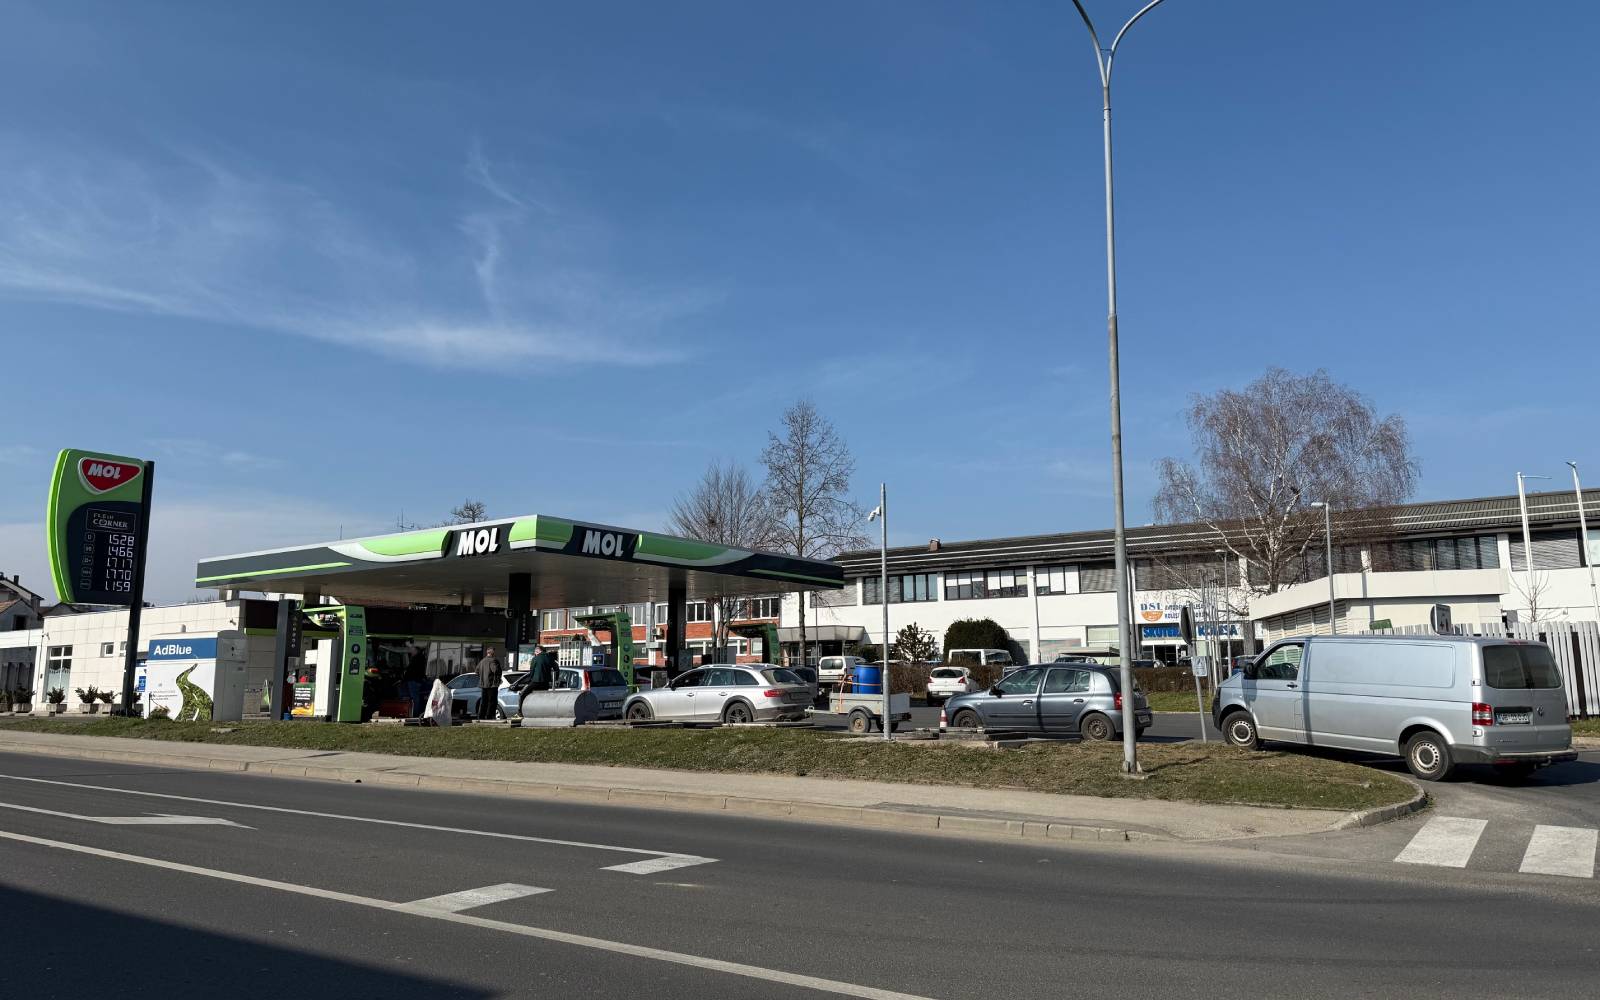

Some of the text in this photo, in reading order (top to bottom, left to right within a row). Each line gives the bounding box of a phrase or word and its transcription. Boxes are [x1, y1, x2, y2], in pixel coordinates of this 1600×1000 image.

[88, 463, 120, 479] MOL
[93, 518, 129, 528] CORNER
[457, 528, 498, 556] MOL
[582, 530, 623, 557] MOL
[1140, 602, 1163, 611] DSL
[153, 644, 192, 655] AdBlue
